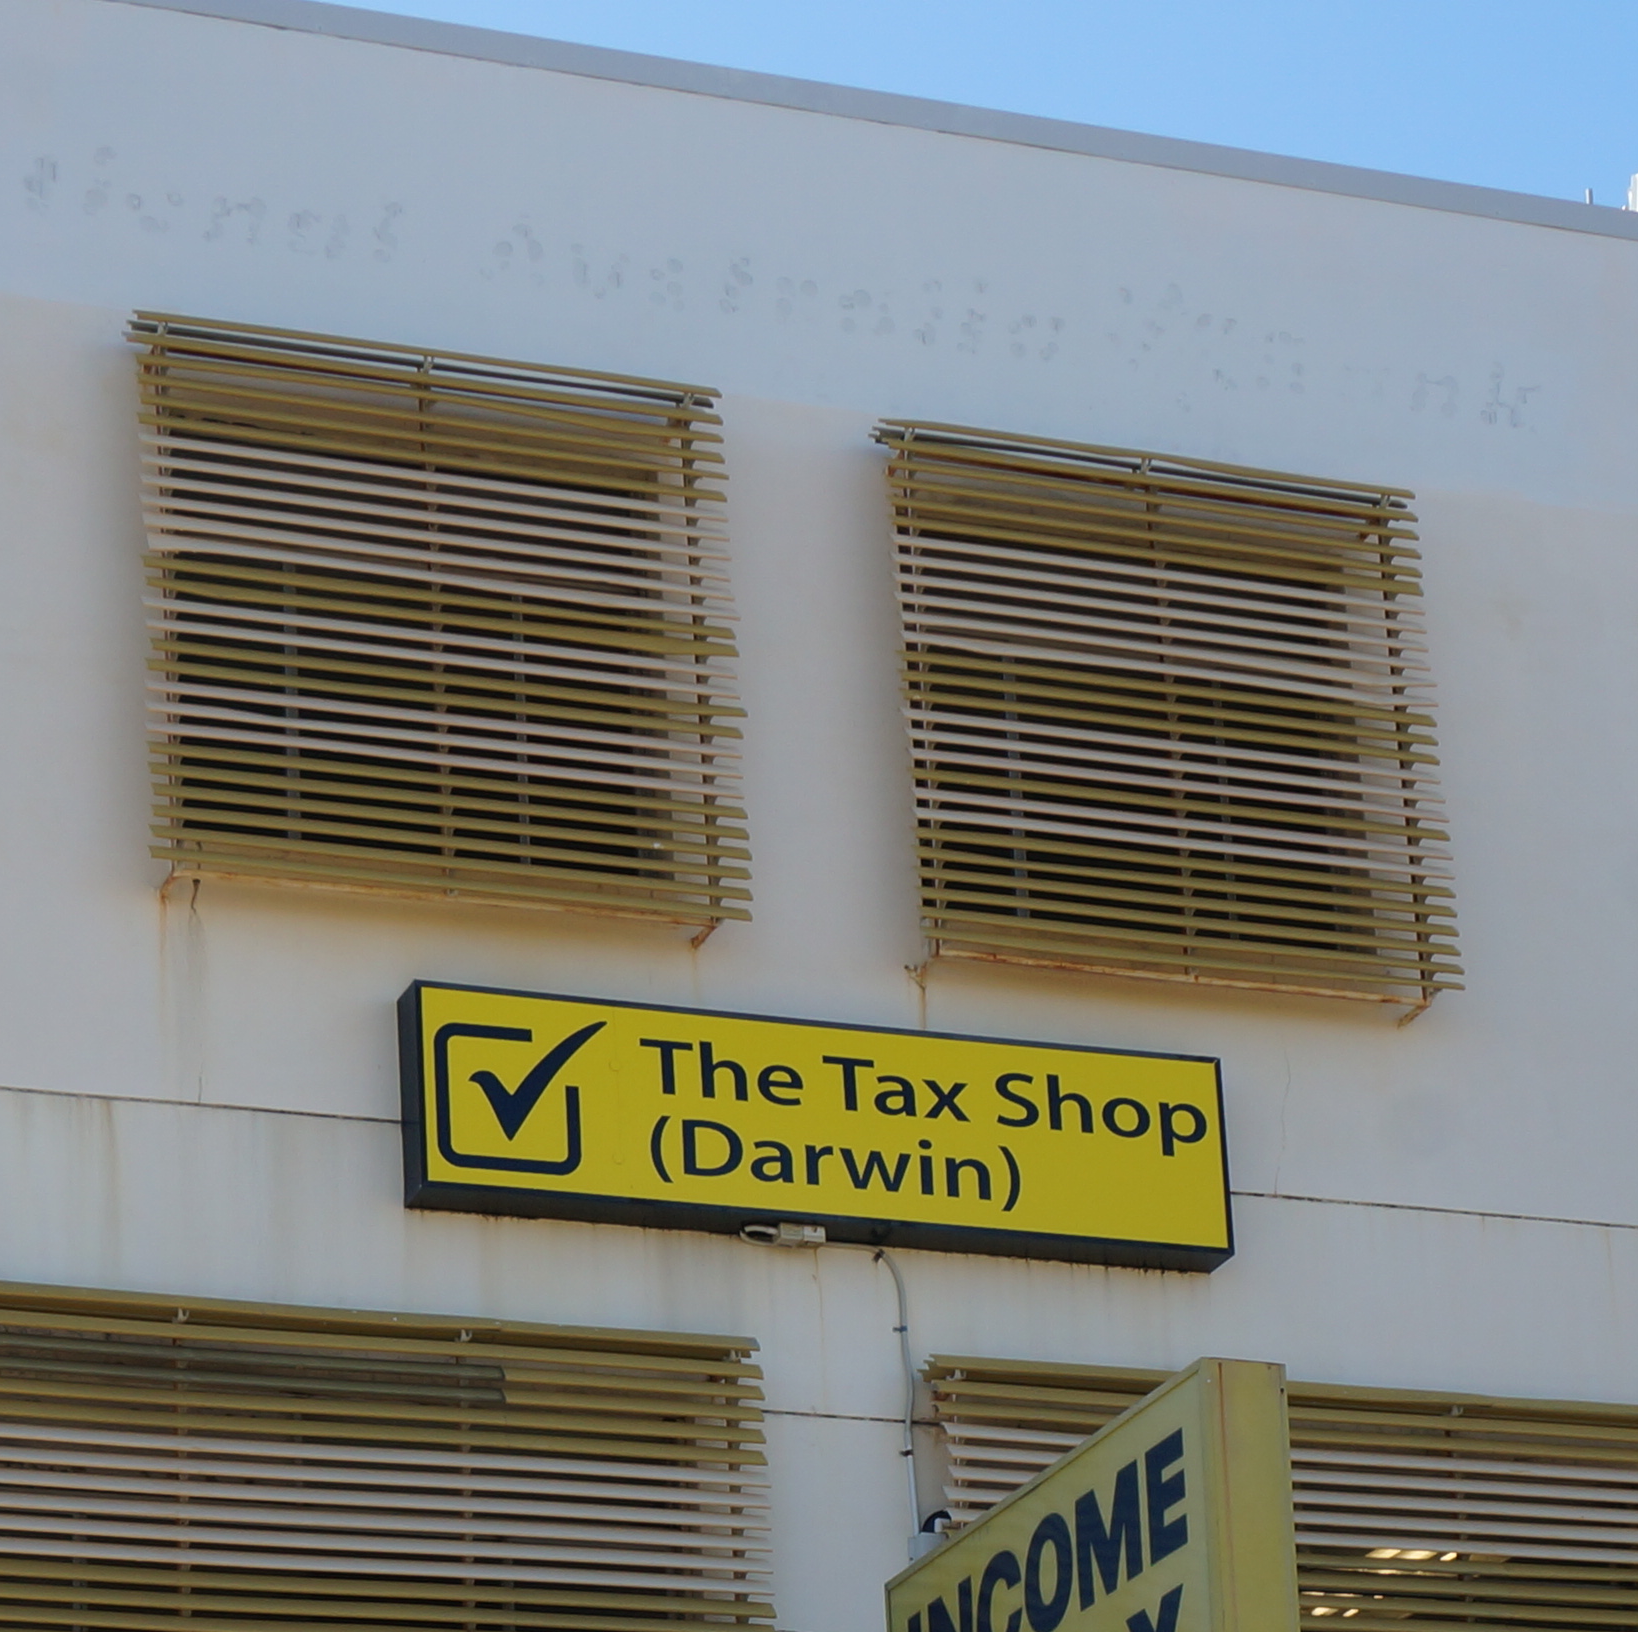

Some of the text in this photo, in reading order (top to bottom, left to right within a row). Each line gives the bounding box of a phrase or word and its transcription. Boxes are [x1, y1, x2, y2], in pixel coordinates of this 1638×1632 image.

[639, 1037, 1209, 1157] The Tax Shop
[649, 1114, 1023, 1213] (Darwin)
